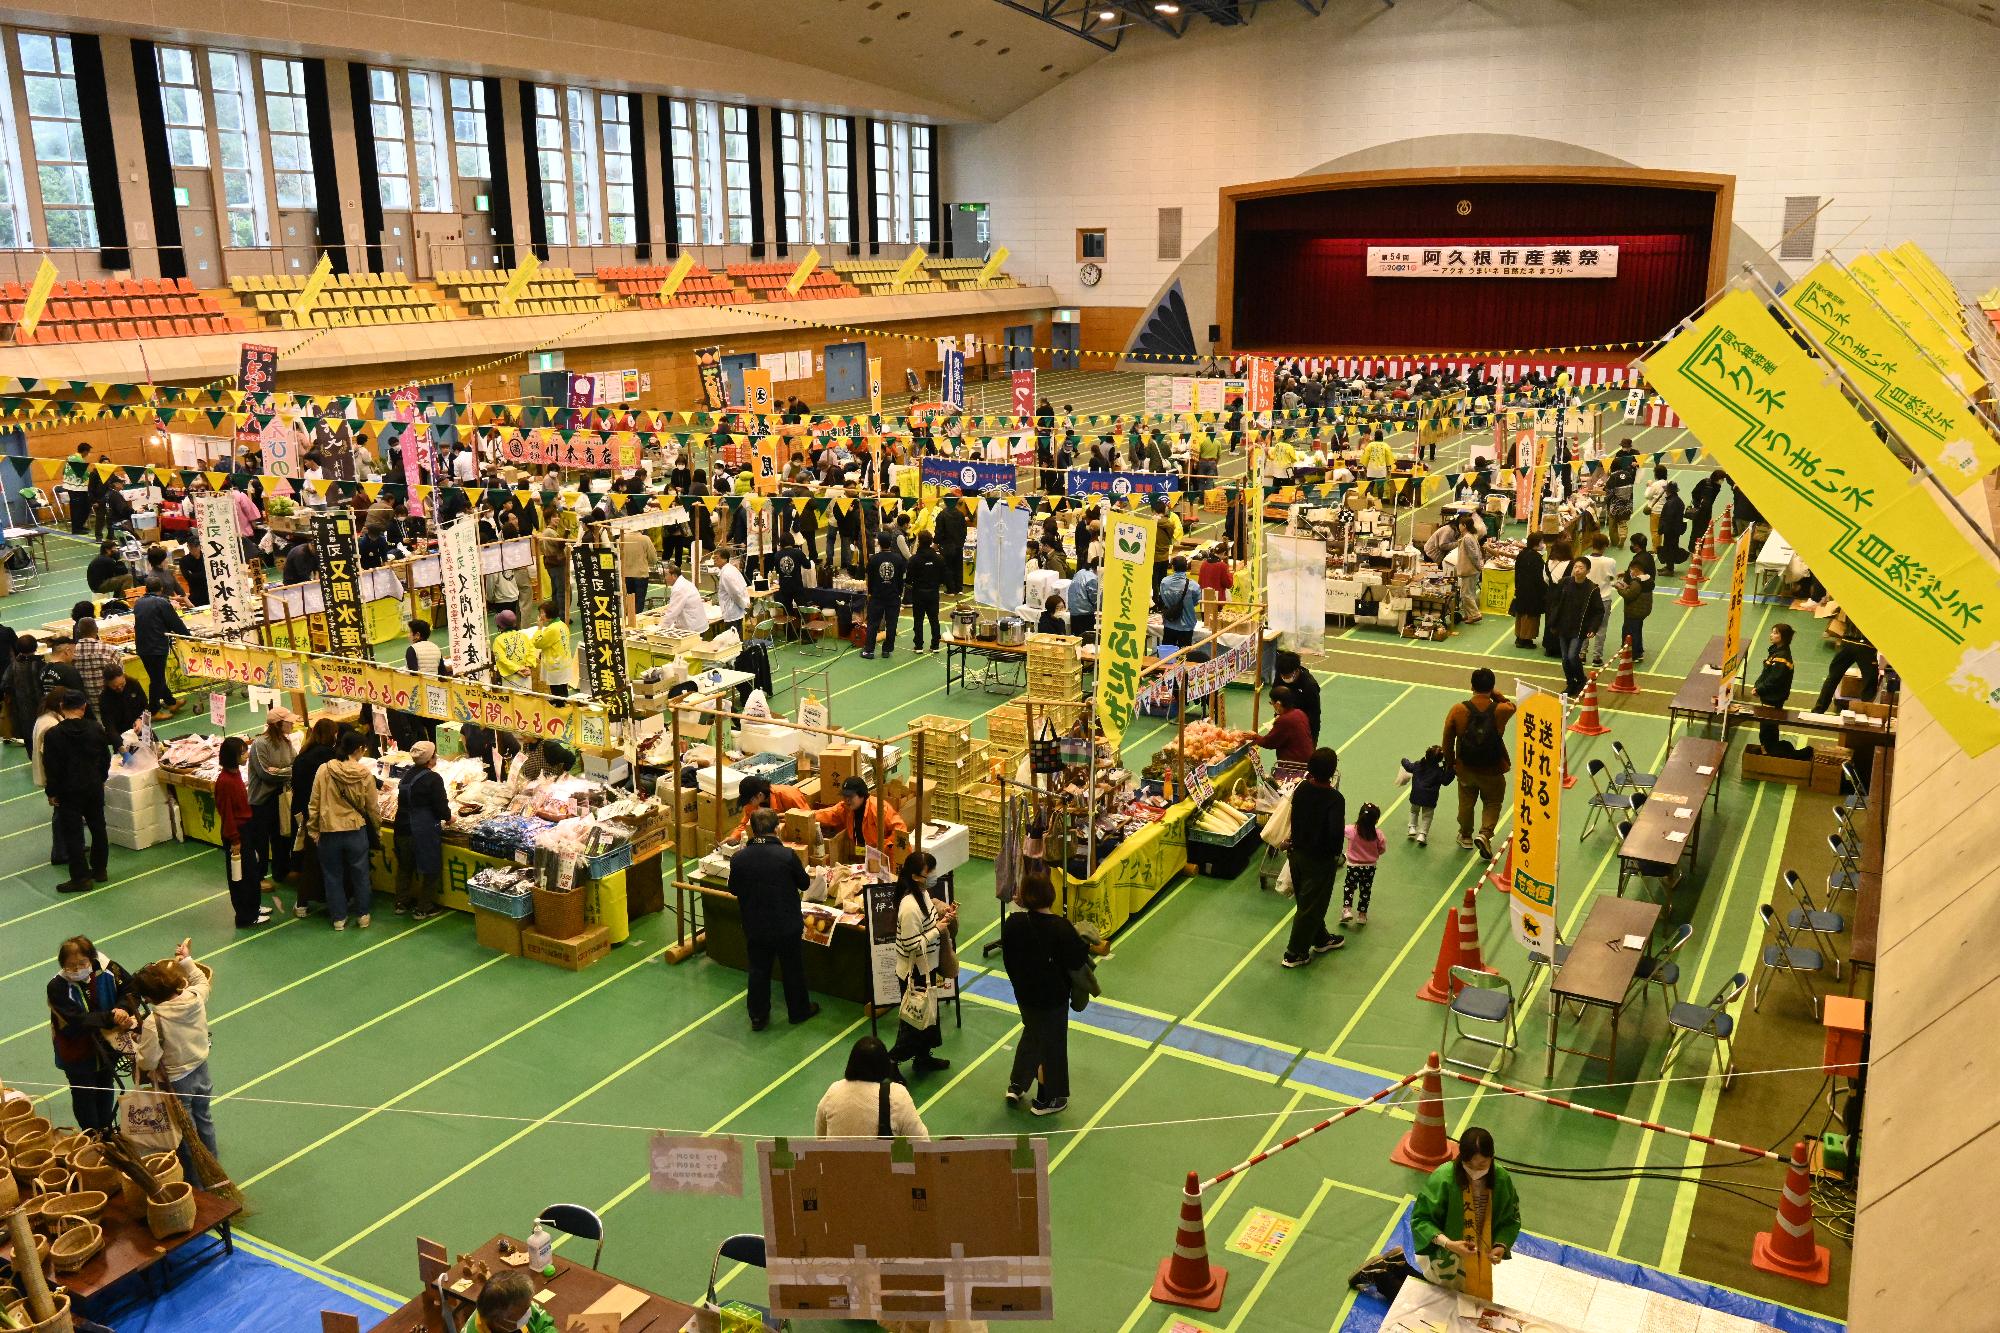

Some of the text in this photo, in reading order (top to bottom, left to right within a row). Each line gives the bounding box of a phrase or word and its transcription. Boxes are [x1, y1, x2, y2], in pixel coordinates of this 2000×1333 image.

[1422, 249, 1600, 266] 阿久根市産業祭
[1805, 290, 1850, 327] アクネ
[1723, 330, 1778, 375] 阿久根特産
[1839, 334, 1898, 376] うまいネ
[1259, 367, 1270, 409] 花いか
[1700, 343, 1786, 415] アクネ
[1889, 386, 1955, 433] 自然だネ
[545, 441, 612, 466] 川本商店
[1764, 430, 1875, 513] うまいネ
[1857, 534, 1984, 629] 自然だネ
[467, 700, 565, 735] 又間のひもの
[1517, 712, 1537, 868] 受け取れる。
[1538, 717, 1554, 820] 送れる、
[1517, 872, 1554, 903] 宅急便
